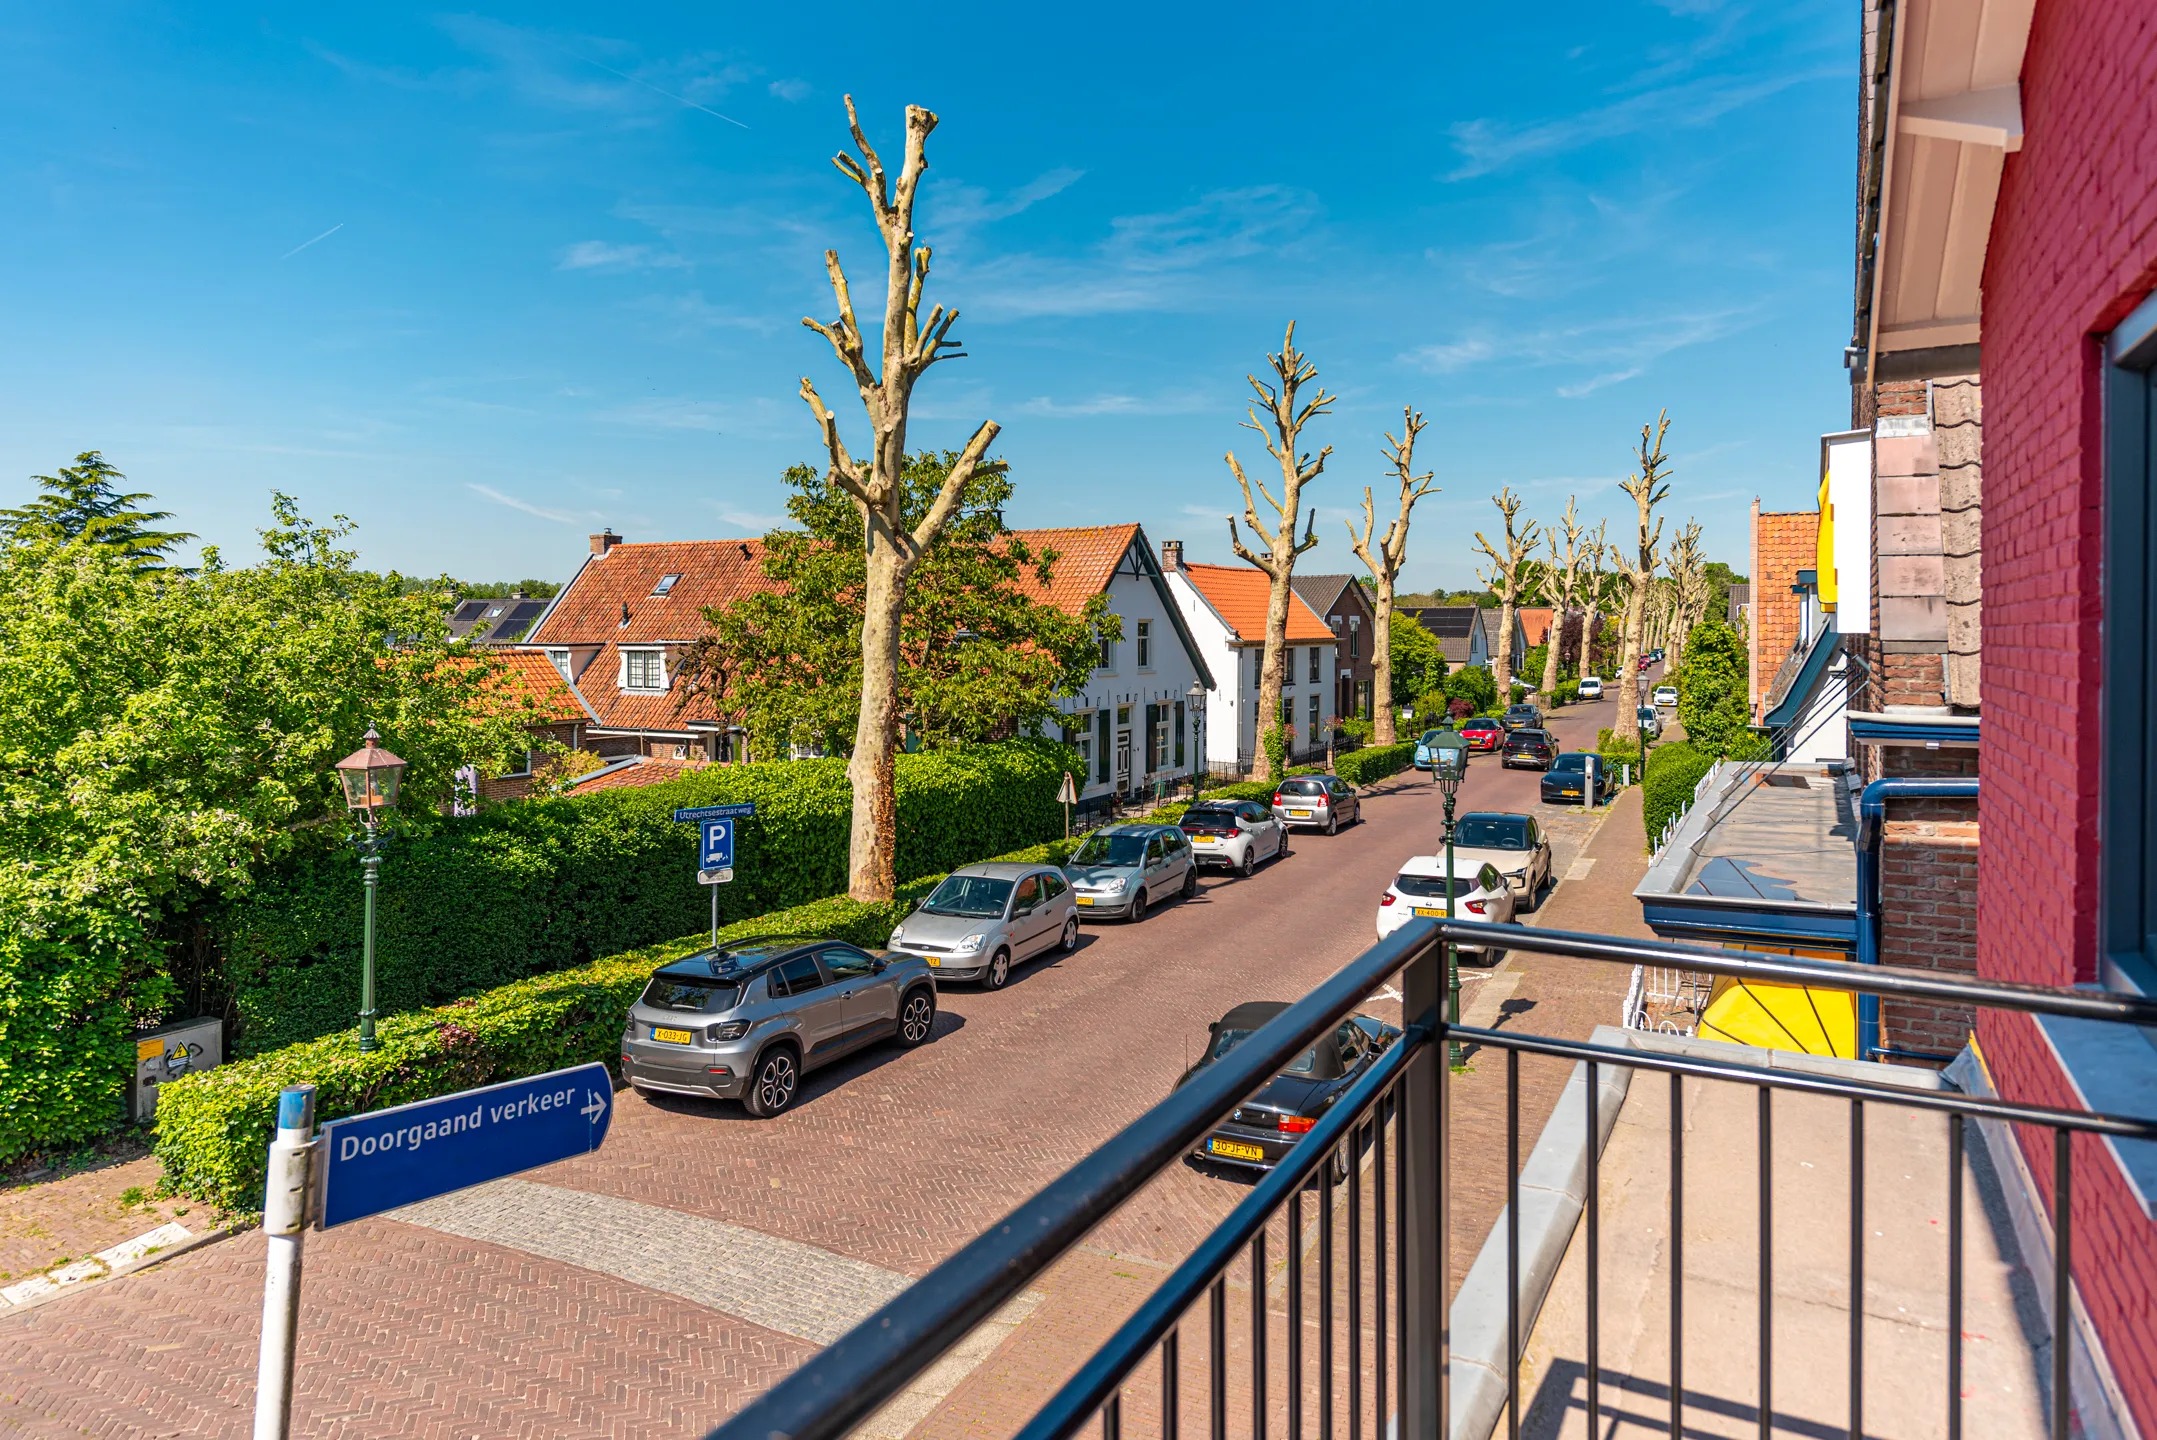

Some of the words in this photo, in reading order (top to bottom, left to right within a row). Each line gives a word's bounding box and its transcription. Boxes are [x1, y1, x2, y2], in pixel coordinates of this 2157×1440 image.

[679, 806, 752, 820] Utrechtsestraatweg
[709, 825, 726, 850] P
[1416, 909, 1445, 918] XX-400-R
[656, 1029, 688, 1042] X-033-JG
[340, 1105, 483, 1162] Doorgaand
[490, 1087, 576, 1124] verkeer
[1215, 1140, 1258, 1156] 30-JF-VN
